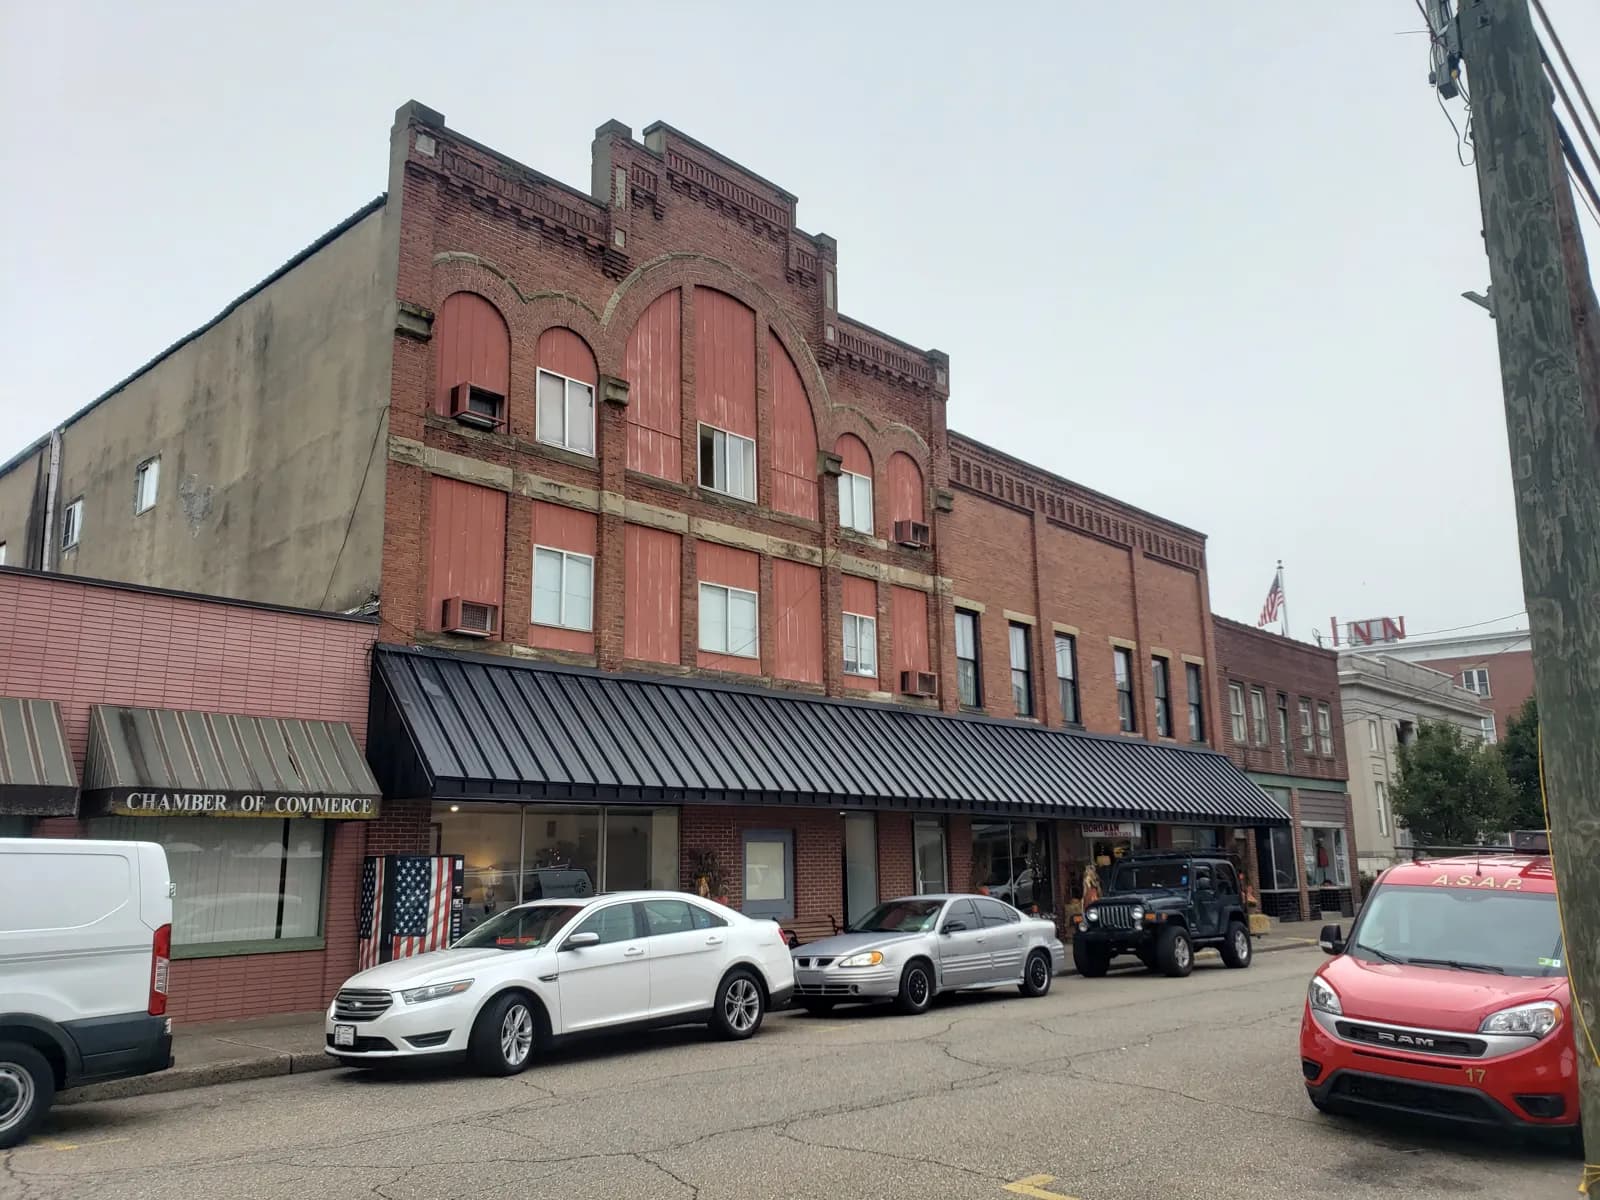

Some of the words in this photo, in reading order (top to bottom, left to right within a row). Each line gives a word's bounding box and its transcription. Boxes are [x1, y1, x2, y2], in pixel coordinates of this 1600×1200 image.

[1330, 616, 1406, 647] INN
[126, 792, 227, 812] CHAMBER
[241, 795, 266, 812] OF
[274, 796, 372, 814] COMMERCE
[1378, 1031, 1434, 1047] RAM
[1465, 1067, 1486, 1083] 17
